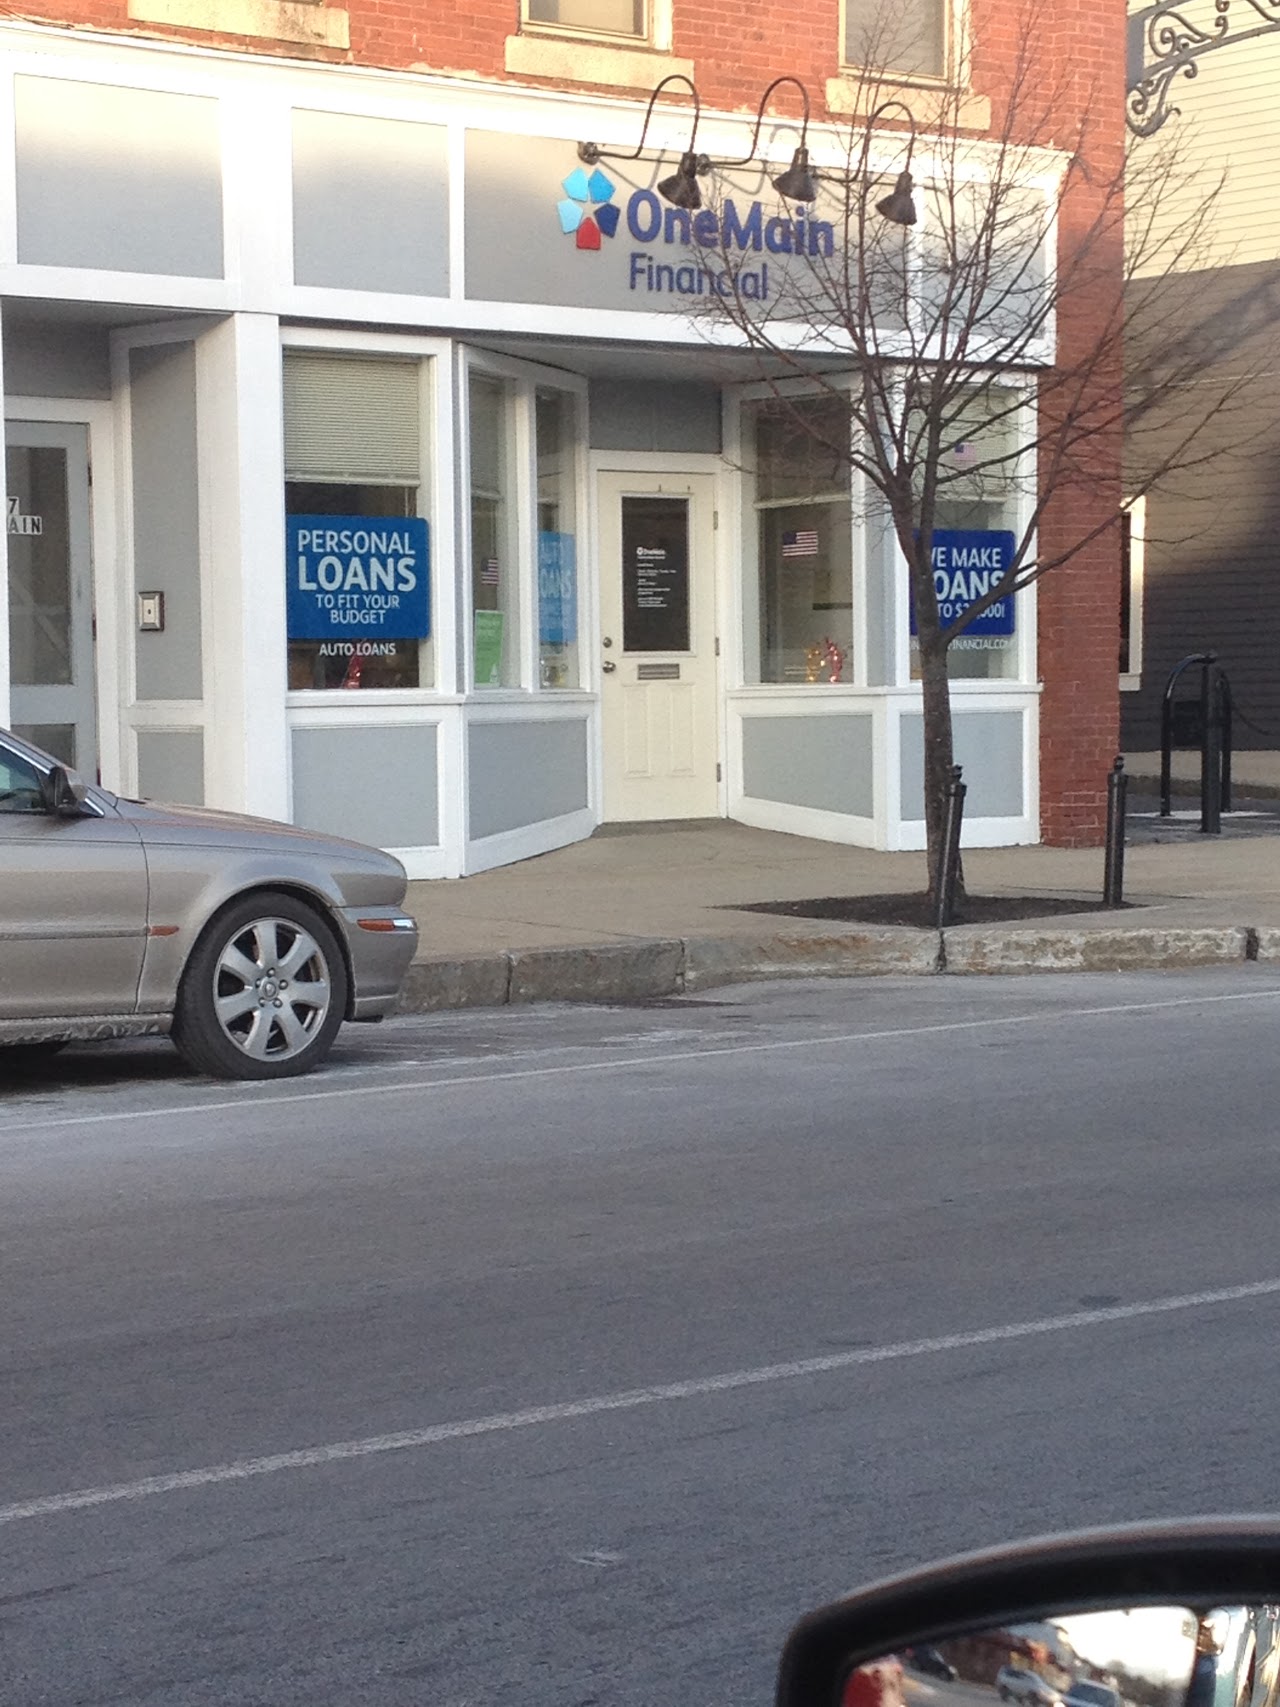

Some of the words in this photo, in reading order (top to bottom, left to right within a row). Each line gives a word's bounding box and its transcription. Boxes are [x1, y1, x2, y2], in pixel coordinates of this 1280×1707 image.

[627, 189, 834, 257] OneMain
[630, 252, 768, 300] Financial
[8, 516, 41, 533] AIN
[298, 529, 415, 555] PERSONAL
[952, 547, 1002, 567] MAKE
[299, 555, 417, 592] LOANS
[933, 569, 1005, 601] OAN
[316, 594, 334, 608] TO
[338, 595, 359, 608] FIT
[363, 595, 400, 608] YOUR
[331, 609, 386, 624] BUDGET
[319, 643, 354, 656] AUTO
[356, 643, 396, 656] LOANS
